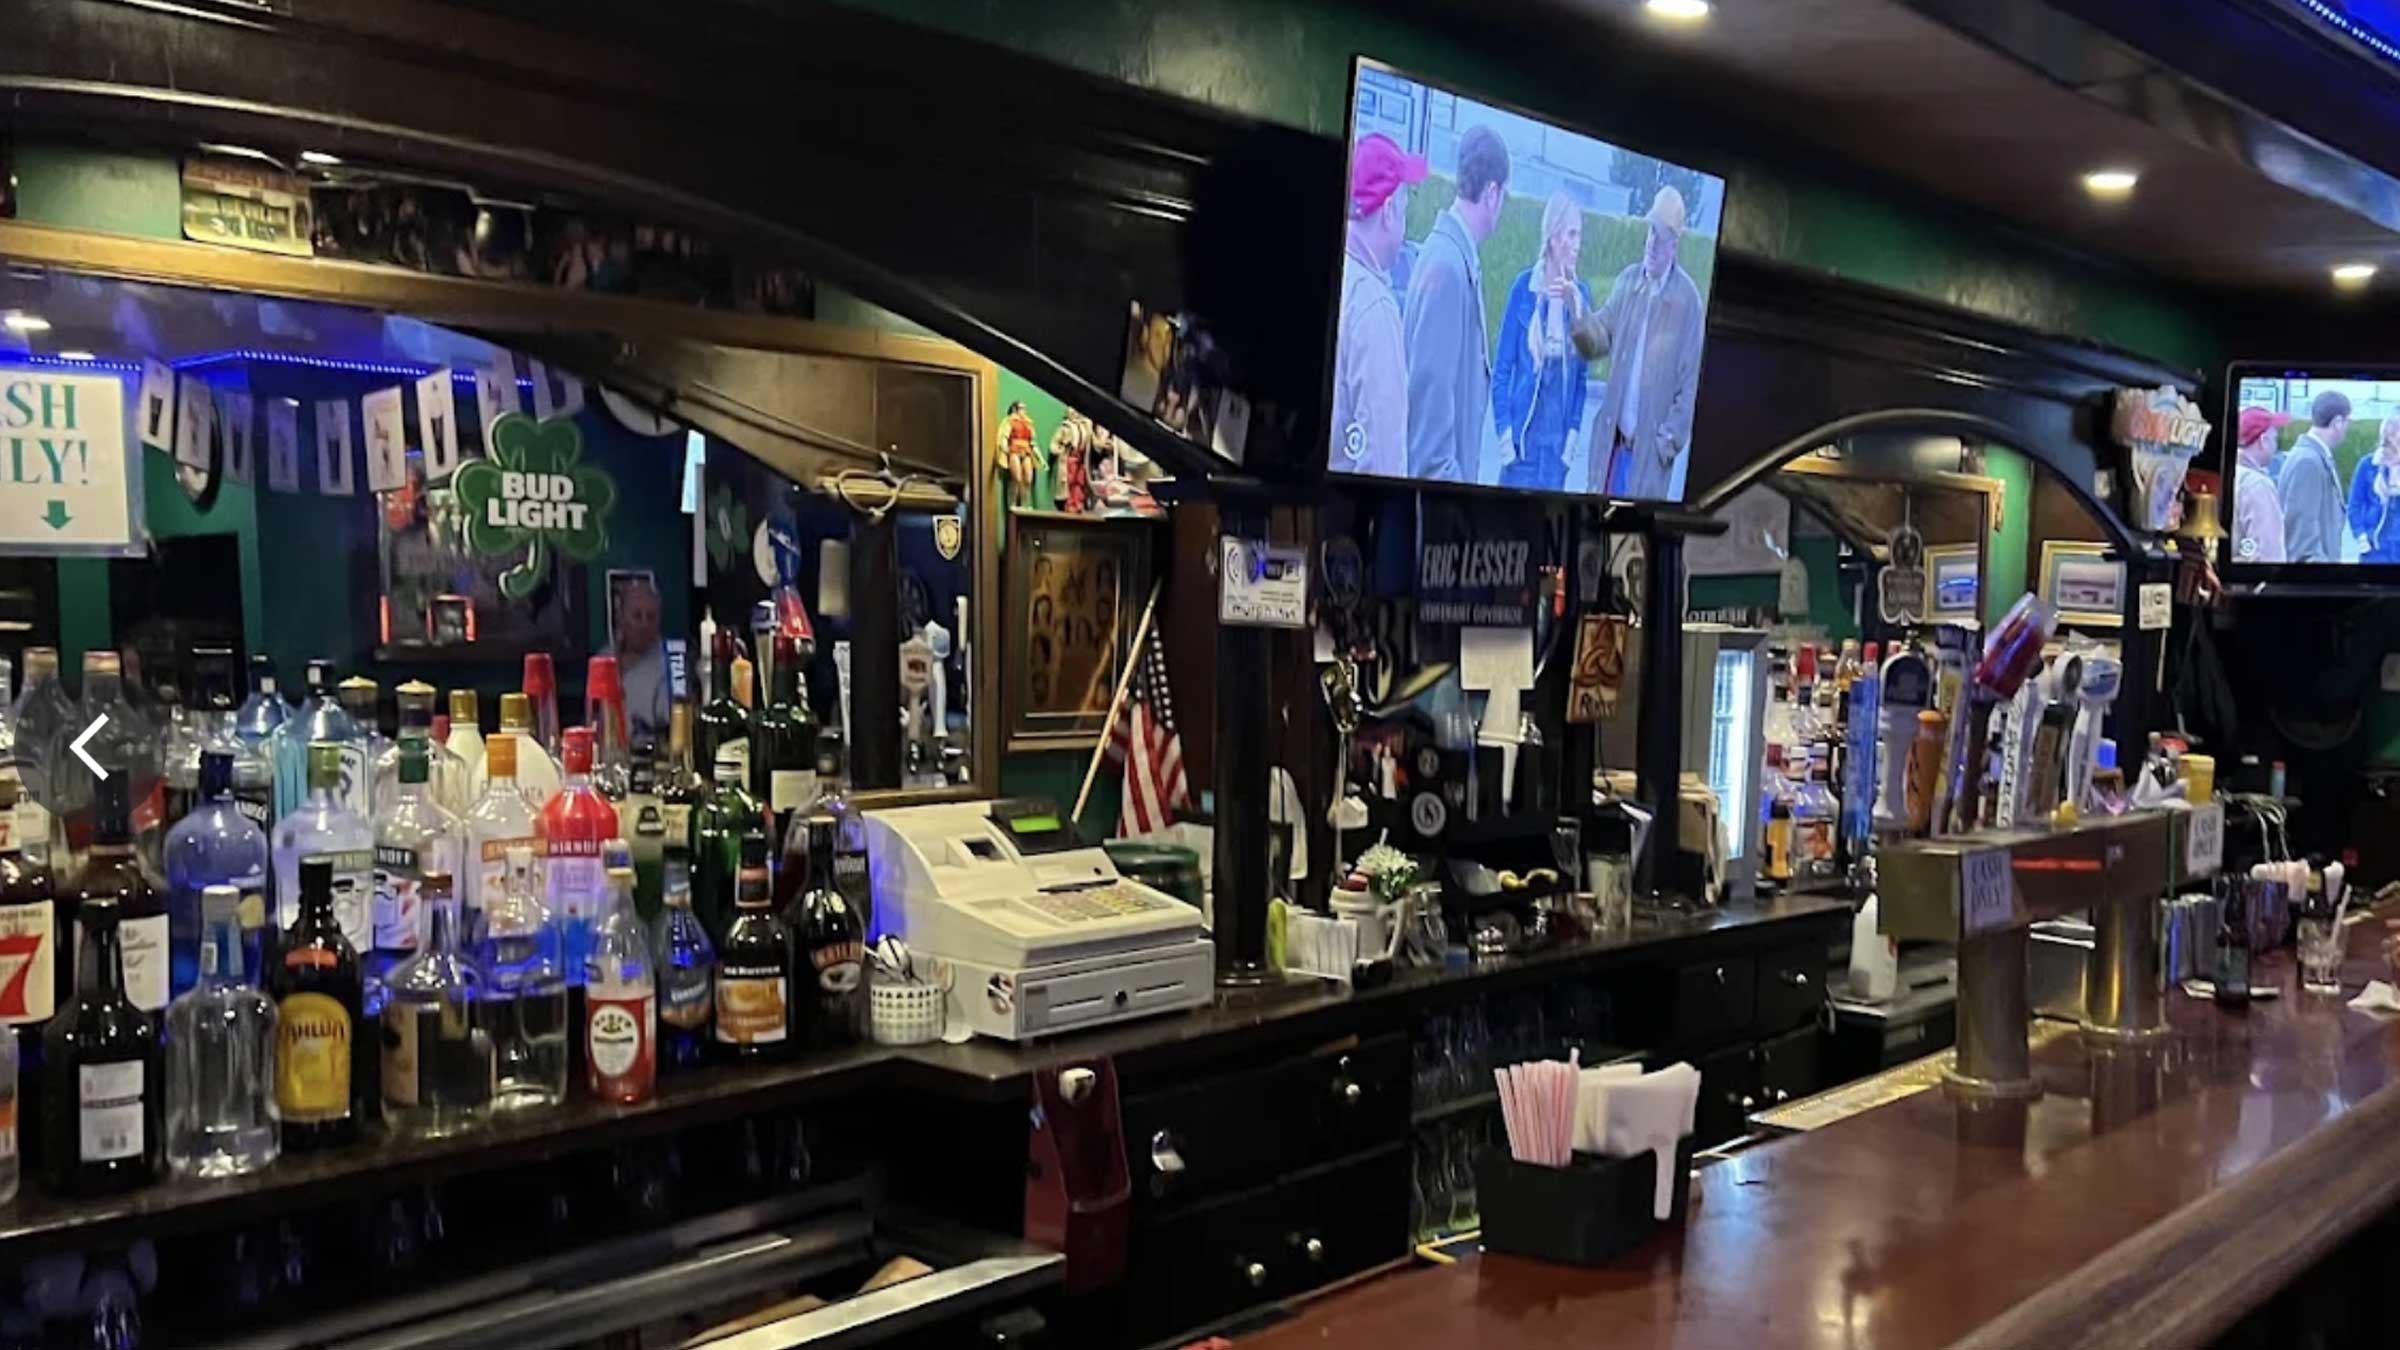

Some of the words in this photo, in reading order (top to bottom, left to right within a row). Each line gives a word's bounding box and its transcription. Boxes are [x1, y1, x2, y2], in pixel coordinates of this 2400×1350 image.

[0, 382, 76, 429] SH
[502, 471, 574, 501] BUD
[488, 497, 588, 530] LIGHT
[1421, 543, 1459, 589] ERIC
[1460, 540, 1529, 587] LESSER
